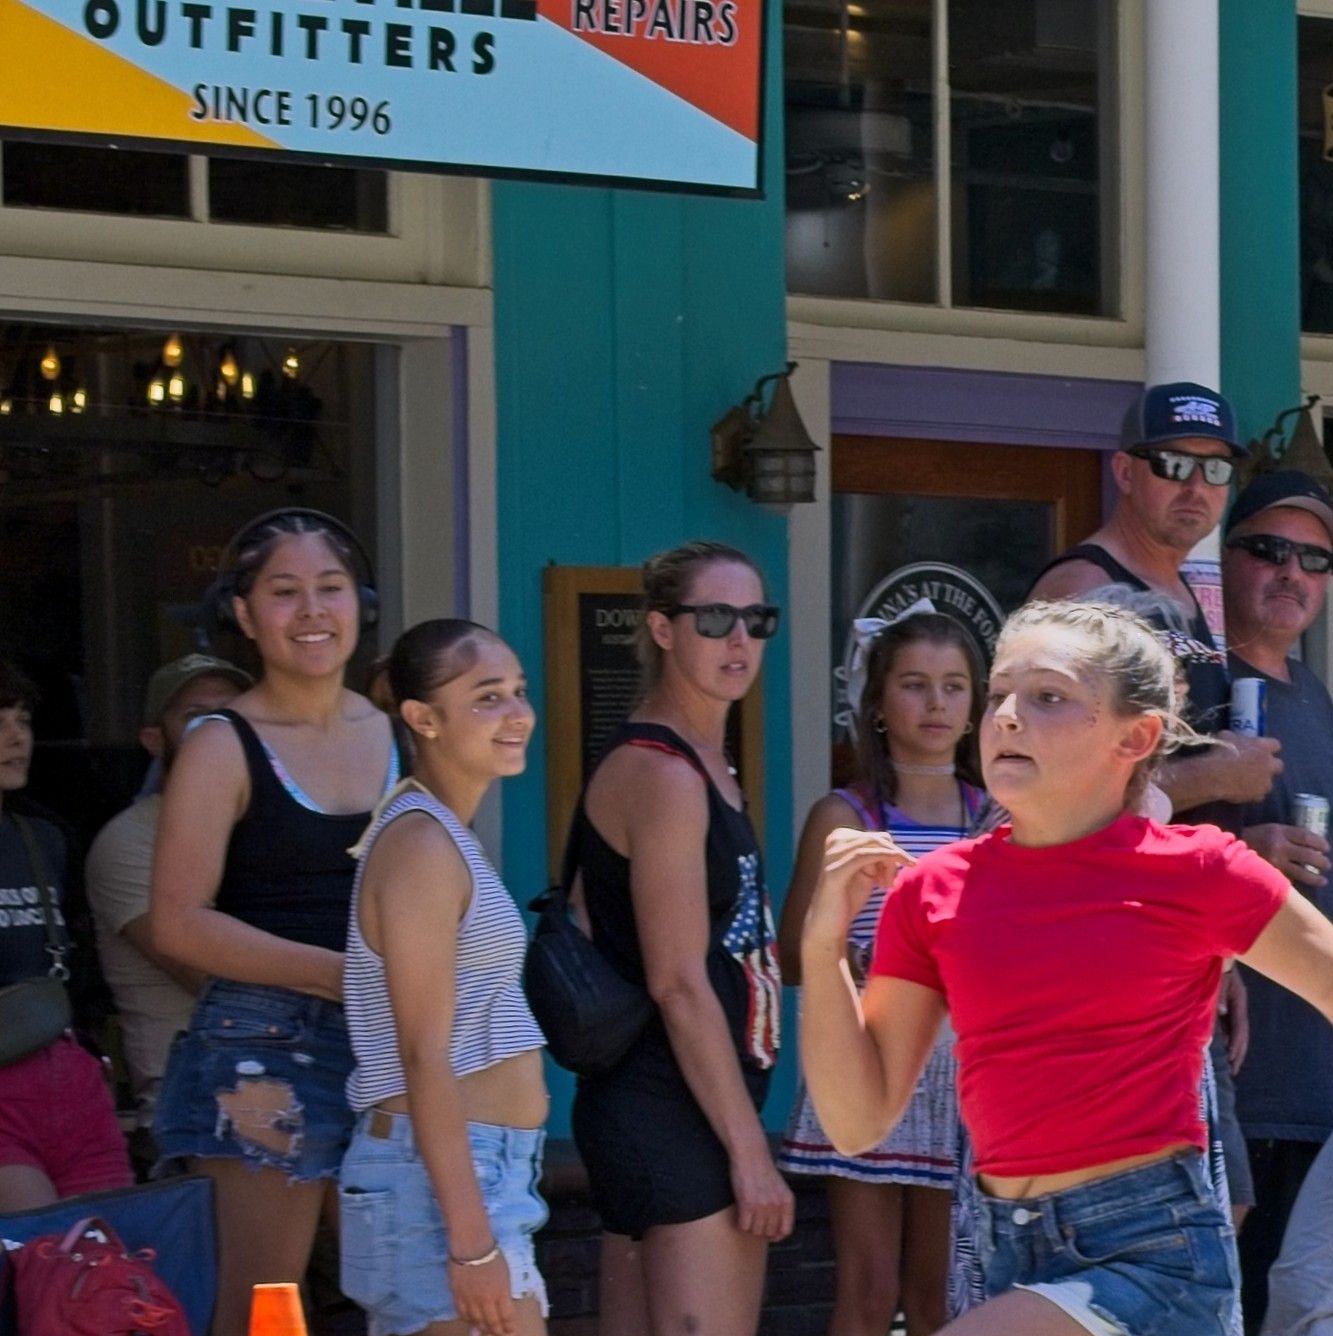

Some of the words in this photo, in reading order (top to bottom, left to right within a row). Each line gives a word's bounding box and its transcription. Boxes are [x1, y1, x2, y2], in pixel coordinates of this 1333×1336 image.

[83, 0, 497, 75] OUTFITTERS
[573, 0, 738, 46] REPAIRS
[191, 83, 292, 126] SINCE
[306, 94, 393, 136] 1996
